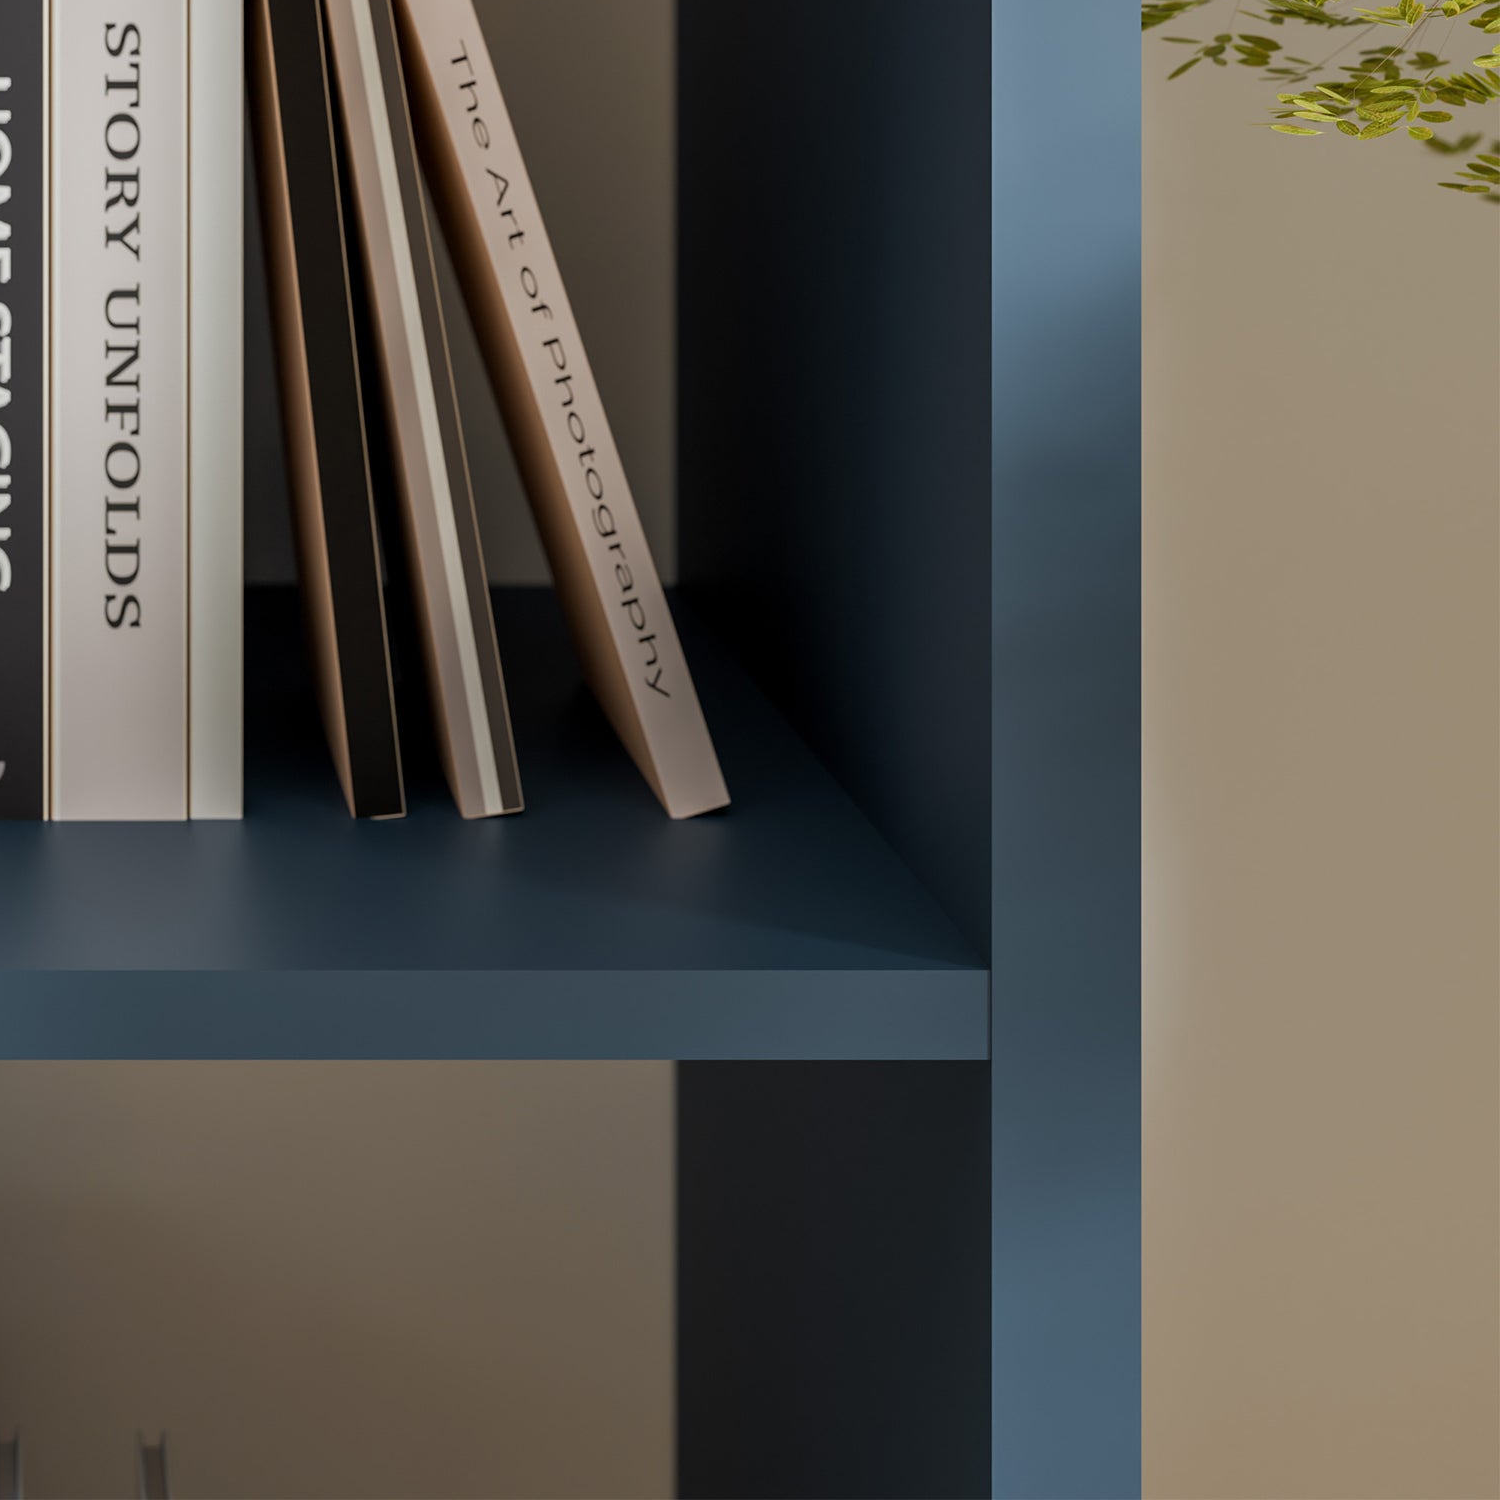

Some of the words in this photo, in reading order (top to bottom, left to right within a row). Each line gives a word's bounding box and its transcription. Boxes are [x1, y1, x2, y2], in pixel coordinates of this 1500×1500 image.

[103, 22, 142, 262] STORY
[103, 282, 142, 631] UNFOLDS
[449, 37, 492, 152] The
[484, 167, 527, 251] Art
[519, 264, 554, 322] of
[541, 336, 672, 699] Photography
